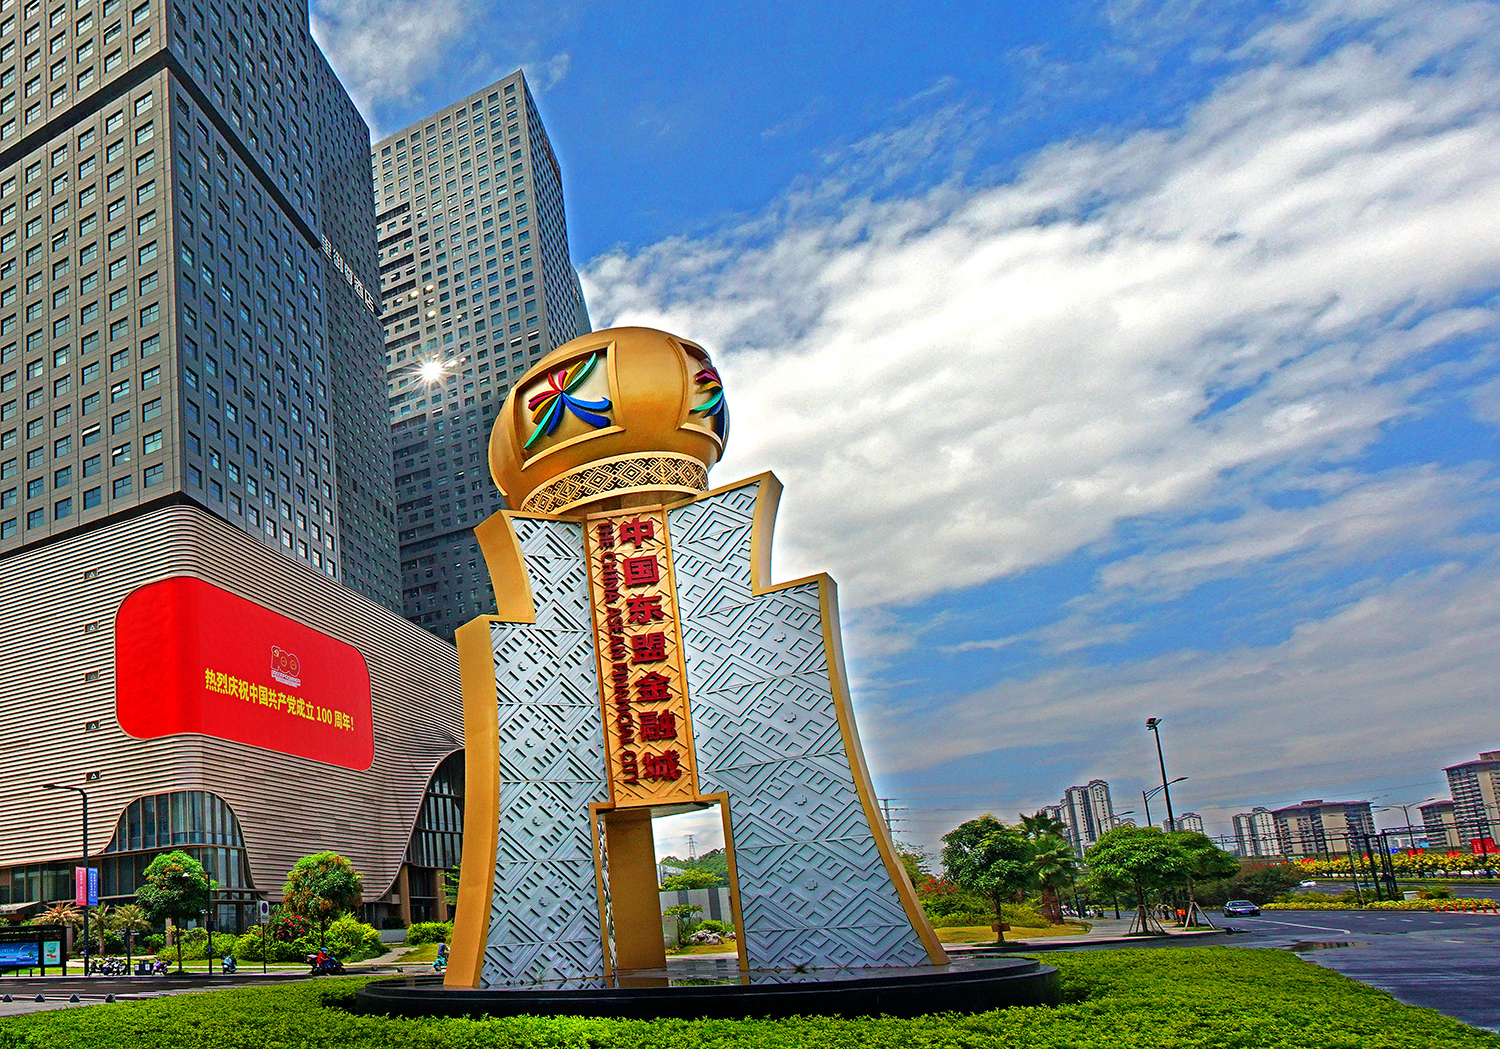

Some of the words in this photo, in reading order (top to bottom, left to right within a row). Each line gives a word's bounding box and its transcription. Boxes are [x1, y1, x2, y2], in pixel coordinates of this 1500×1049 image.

[598, 519, 615, 550] THE
[601, 551, 620, 604] CHINA
[607, 608, 626, 660] ASEAN
[620, 518, 682, 782] 中国东盟金融城
[205, 668, 315, 721] 热烈庆祝中国共产党成立
[316, 706, 333, 725] 100
[612, 662, 634, 746] FINANCIAL
[621, 750, 640, 785] CITY
